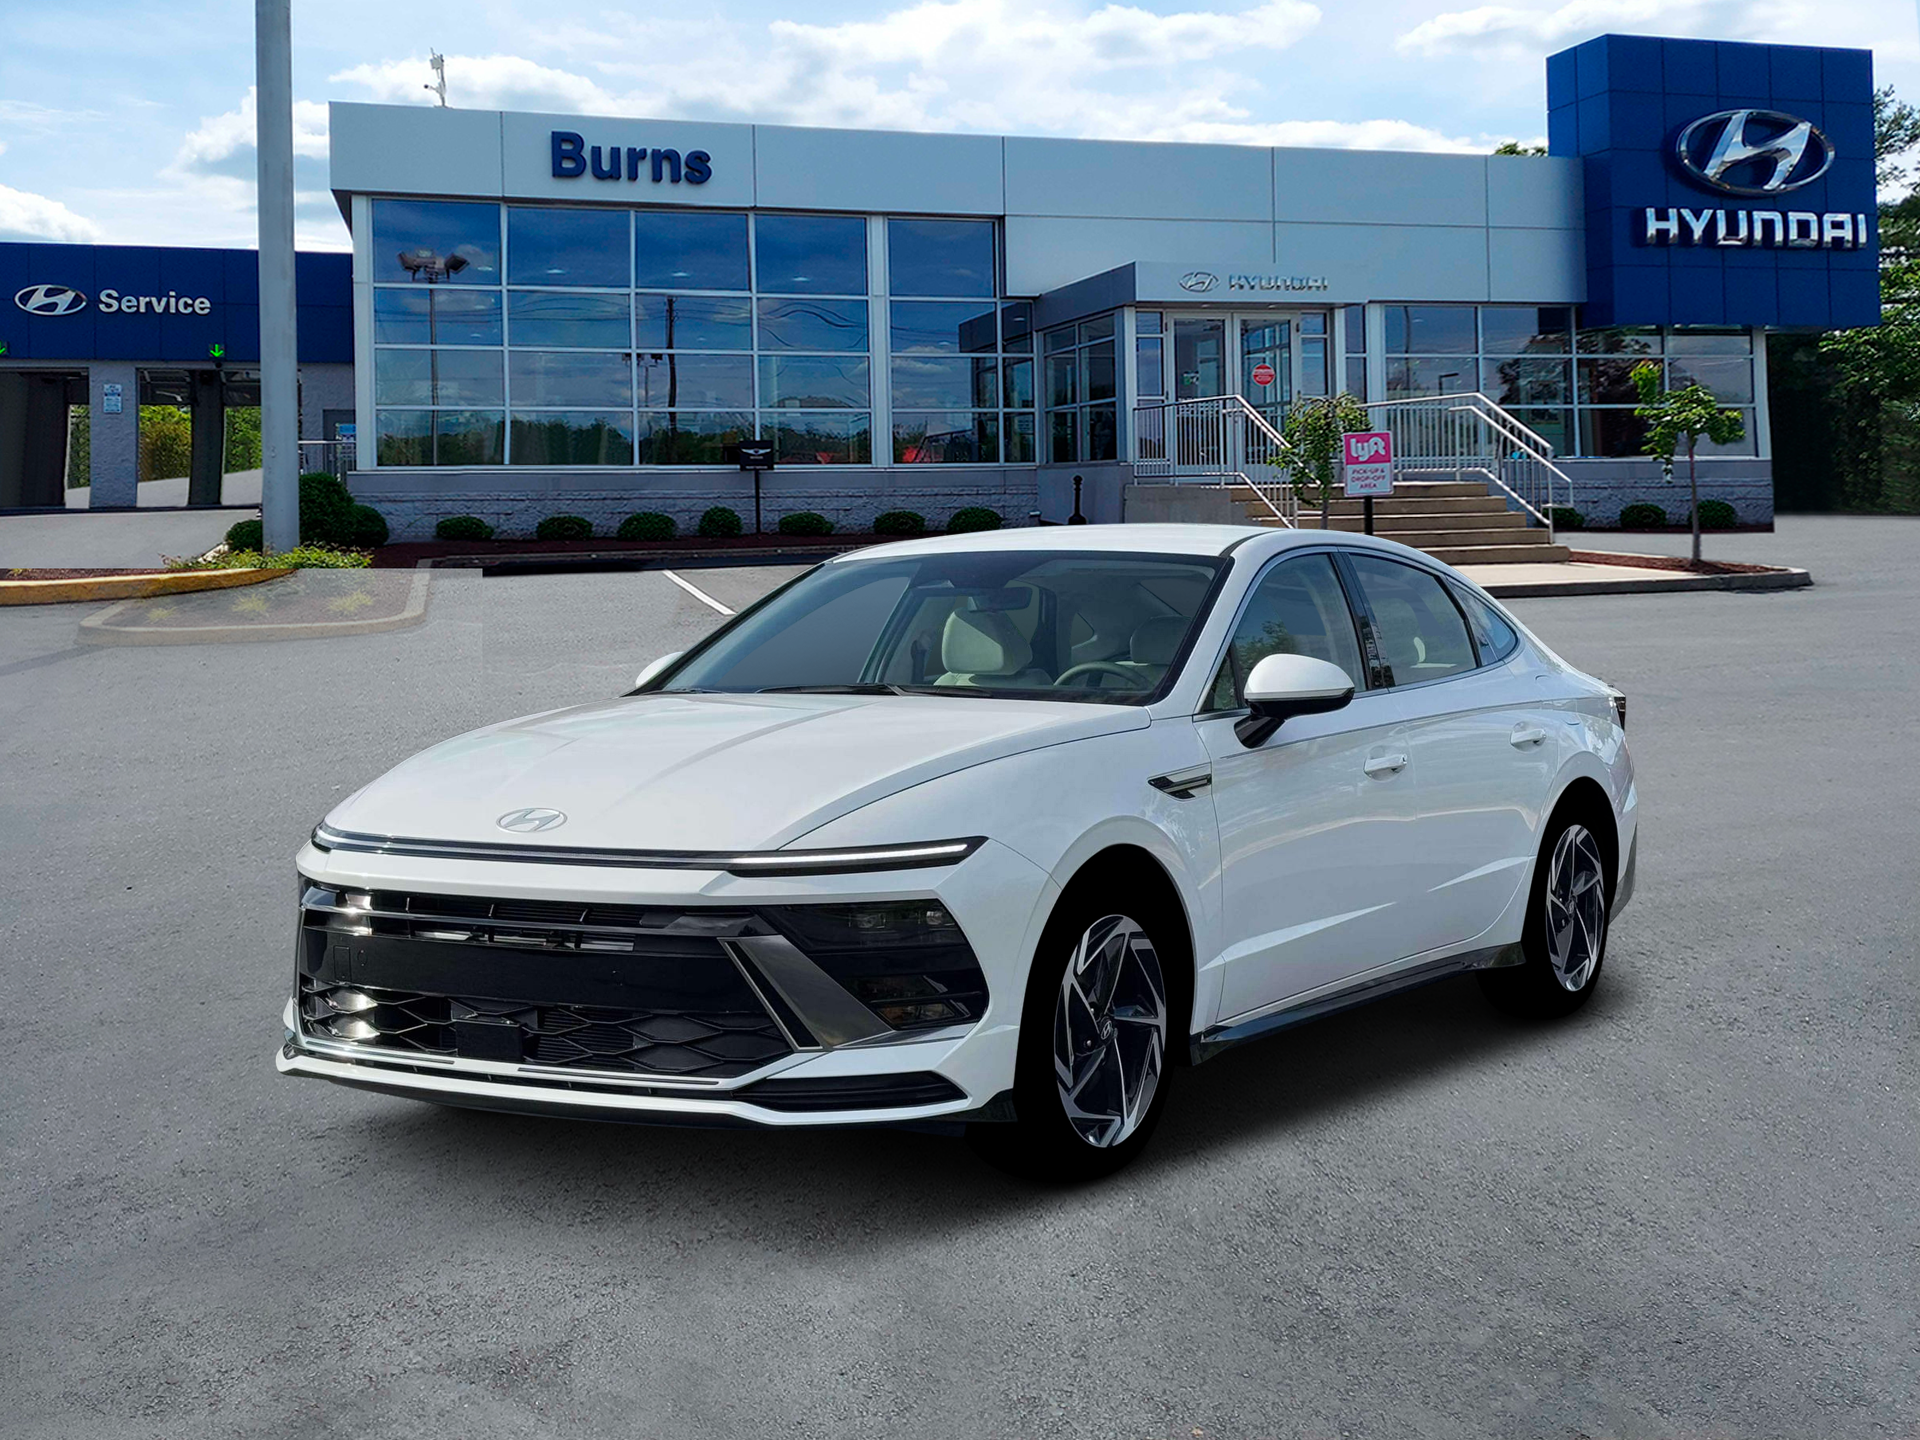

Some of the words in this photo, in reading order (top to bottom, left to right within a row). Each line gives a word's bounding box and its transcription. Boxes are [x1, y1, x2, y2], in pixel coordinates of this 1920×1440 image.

[551, 131, 712, 184] Burns
[1645, 207, 1867, 247] HYUNDAI
[1229, 274, 1328, 291] HYUNDAI
[98, 289, 211, 314] Service
